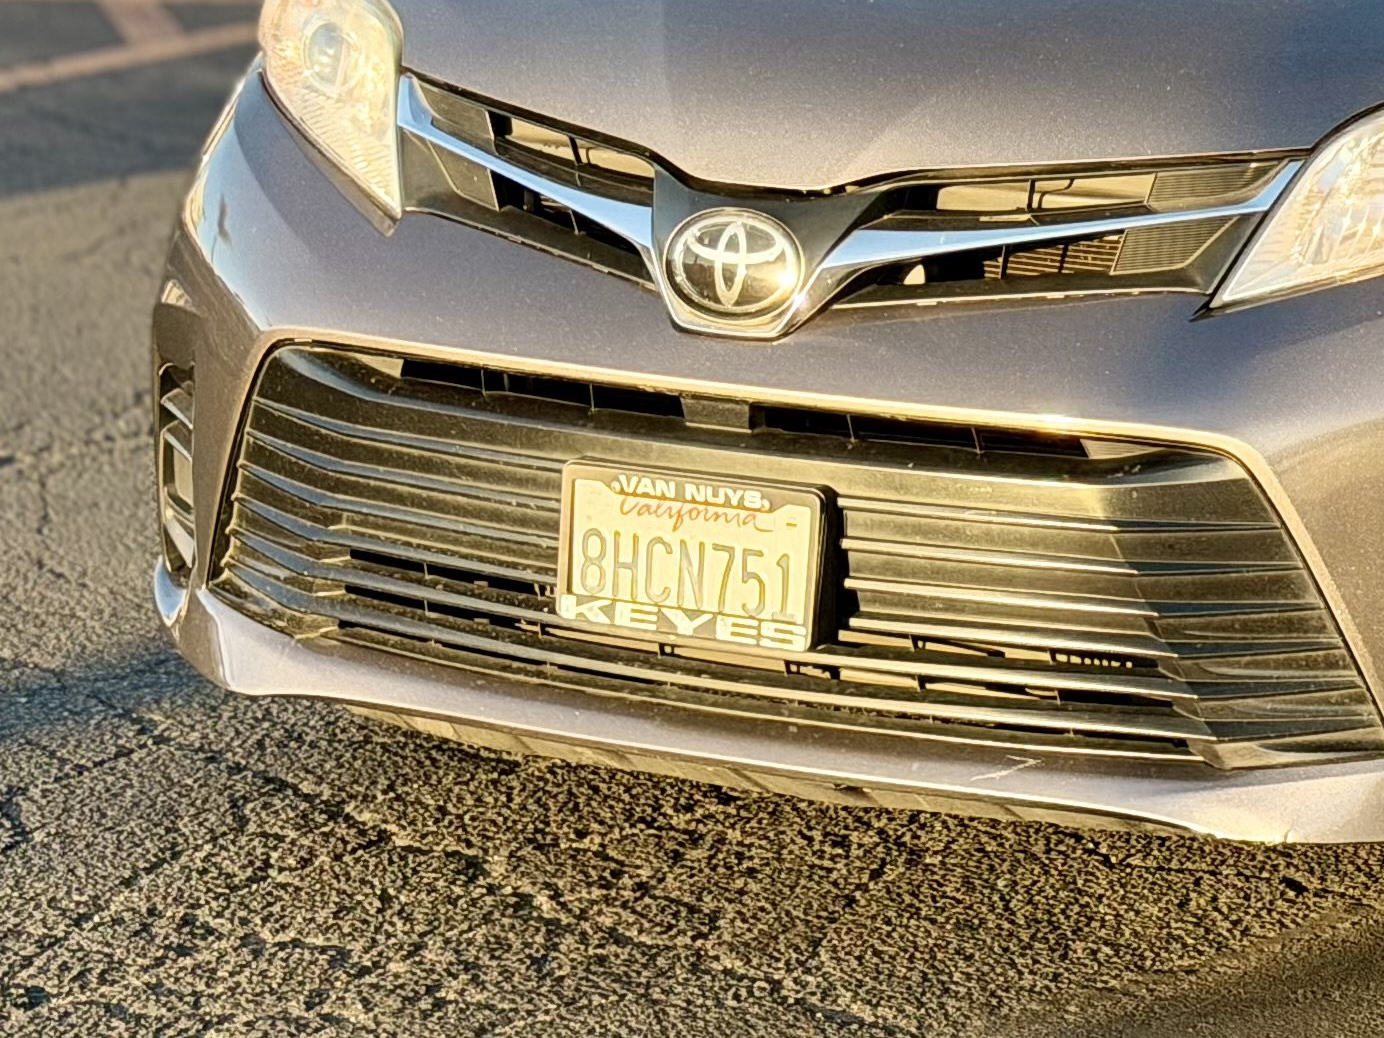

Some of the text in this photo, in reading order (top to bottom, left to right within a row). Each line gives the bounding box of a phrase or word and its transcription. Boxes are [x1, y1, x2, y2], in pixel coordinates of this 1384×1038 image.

[617, 474, 763, 510] VAN NUYS
[619, 497, 774, 533] California
[580, 527, 797, 622] 8HCN751
[560, 594, 807, 652] KEYES
